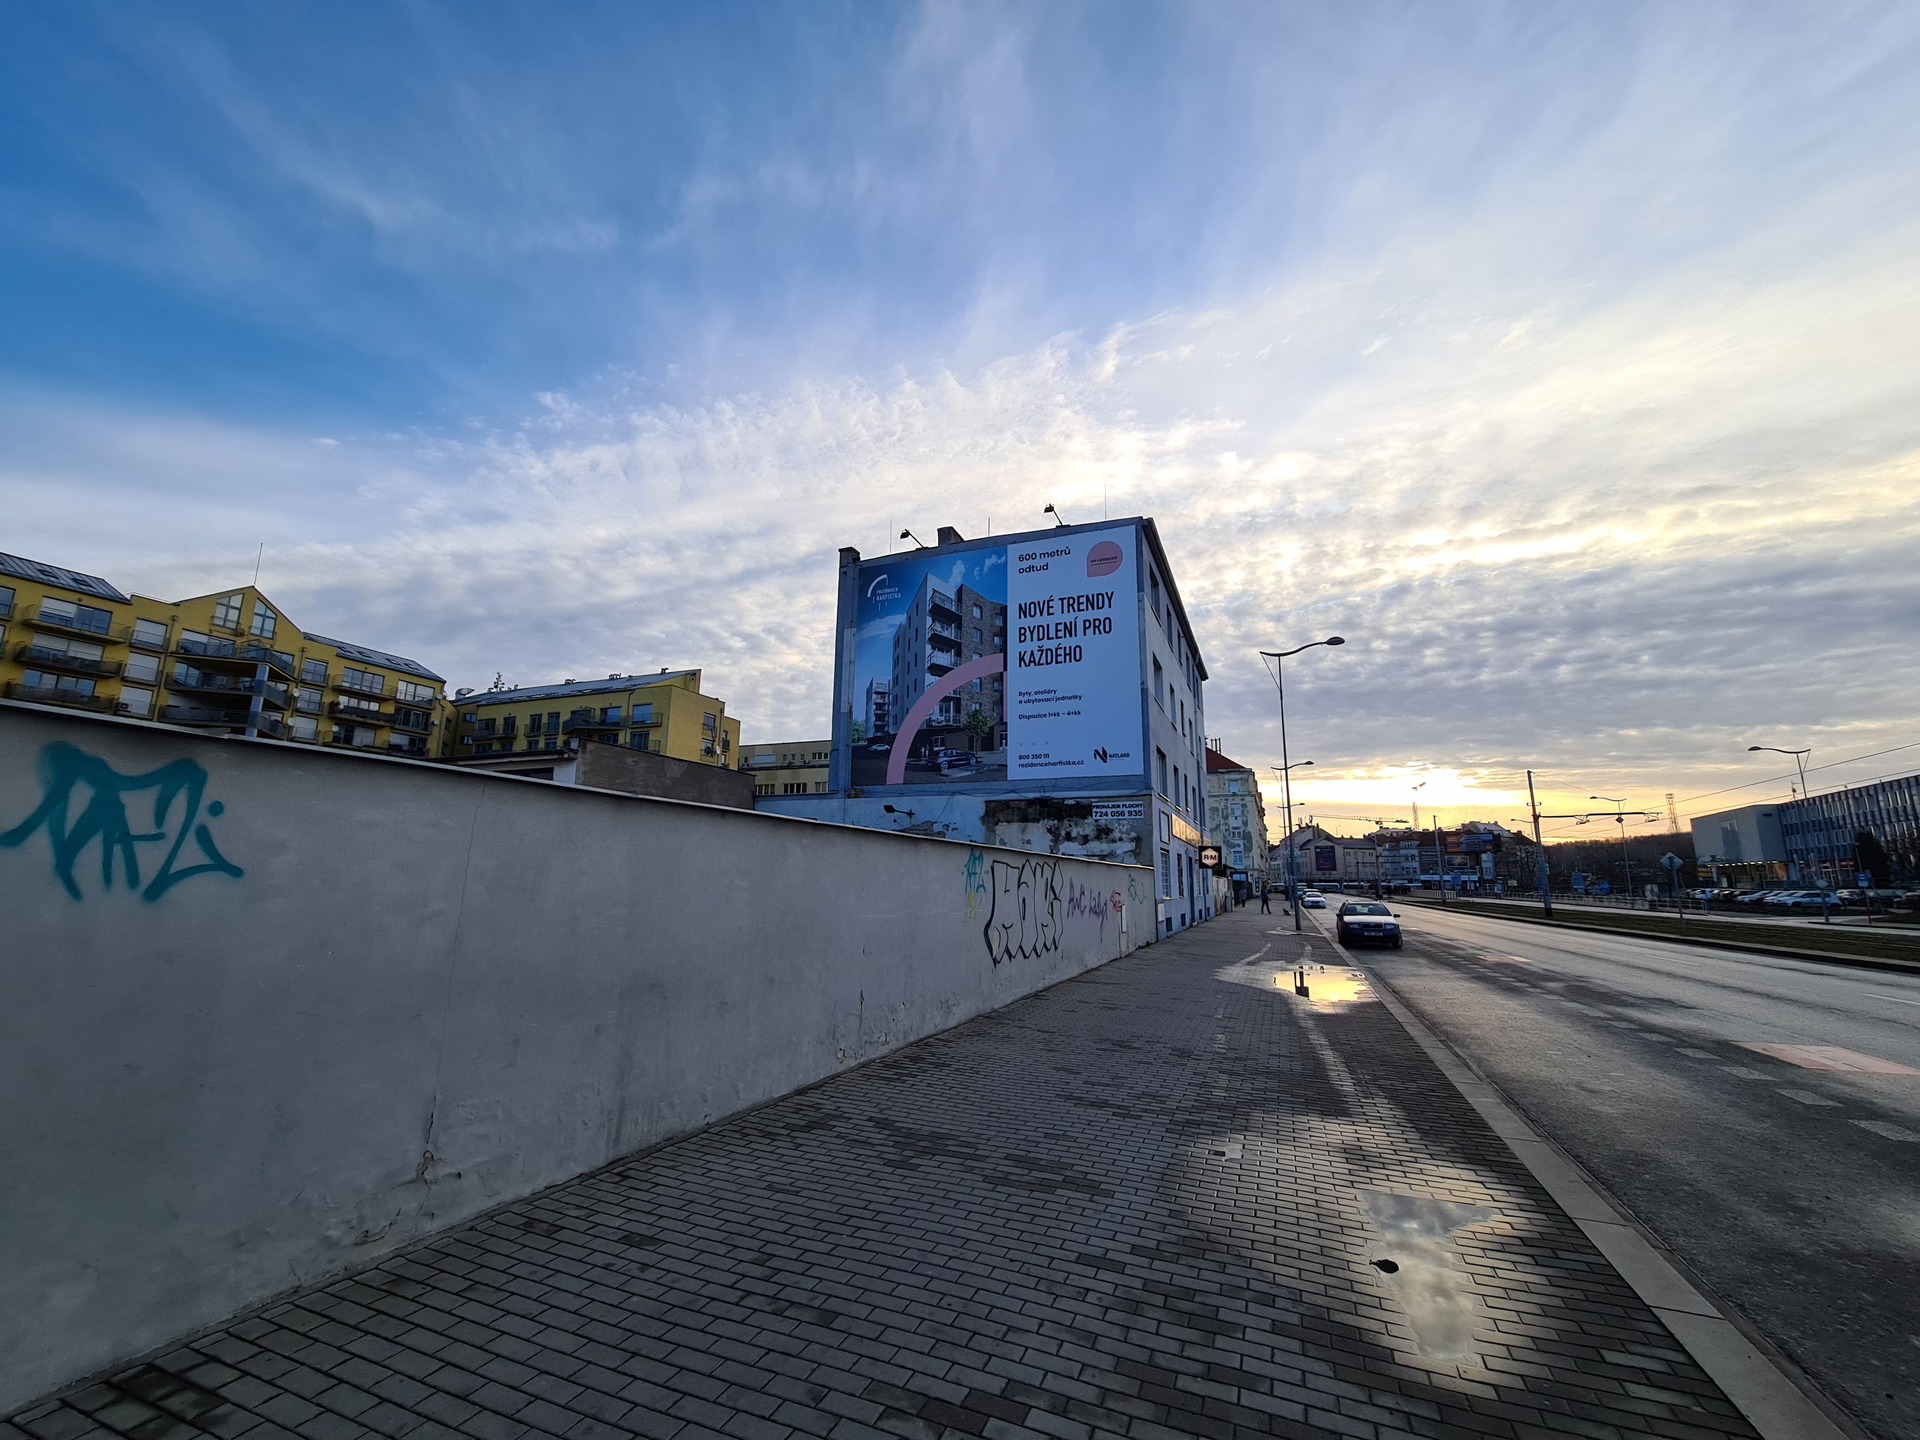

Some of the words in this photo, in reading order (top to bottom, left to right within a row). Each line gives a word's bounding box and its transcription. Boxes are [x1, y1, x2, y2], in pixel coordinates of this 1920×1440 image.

[1018, 552, 1037, 562] 600
[1040, 546, 1071, 558] metrů
[1018, 562, 1049, 574] odtud
[1018, 595, 1054, 619] NOVÉ
[1058, 591, 1114, 614] TRENDY
[1018, 616, 1078, 643] BYDLENÍ
[1083, 616, 1112, 636] PRO
[1018, 643, 1082, 668] KAŽDÉHO
[1055, 694, 1082, 703] jednotky
[1093, 810, 1109, 818] 724
